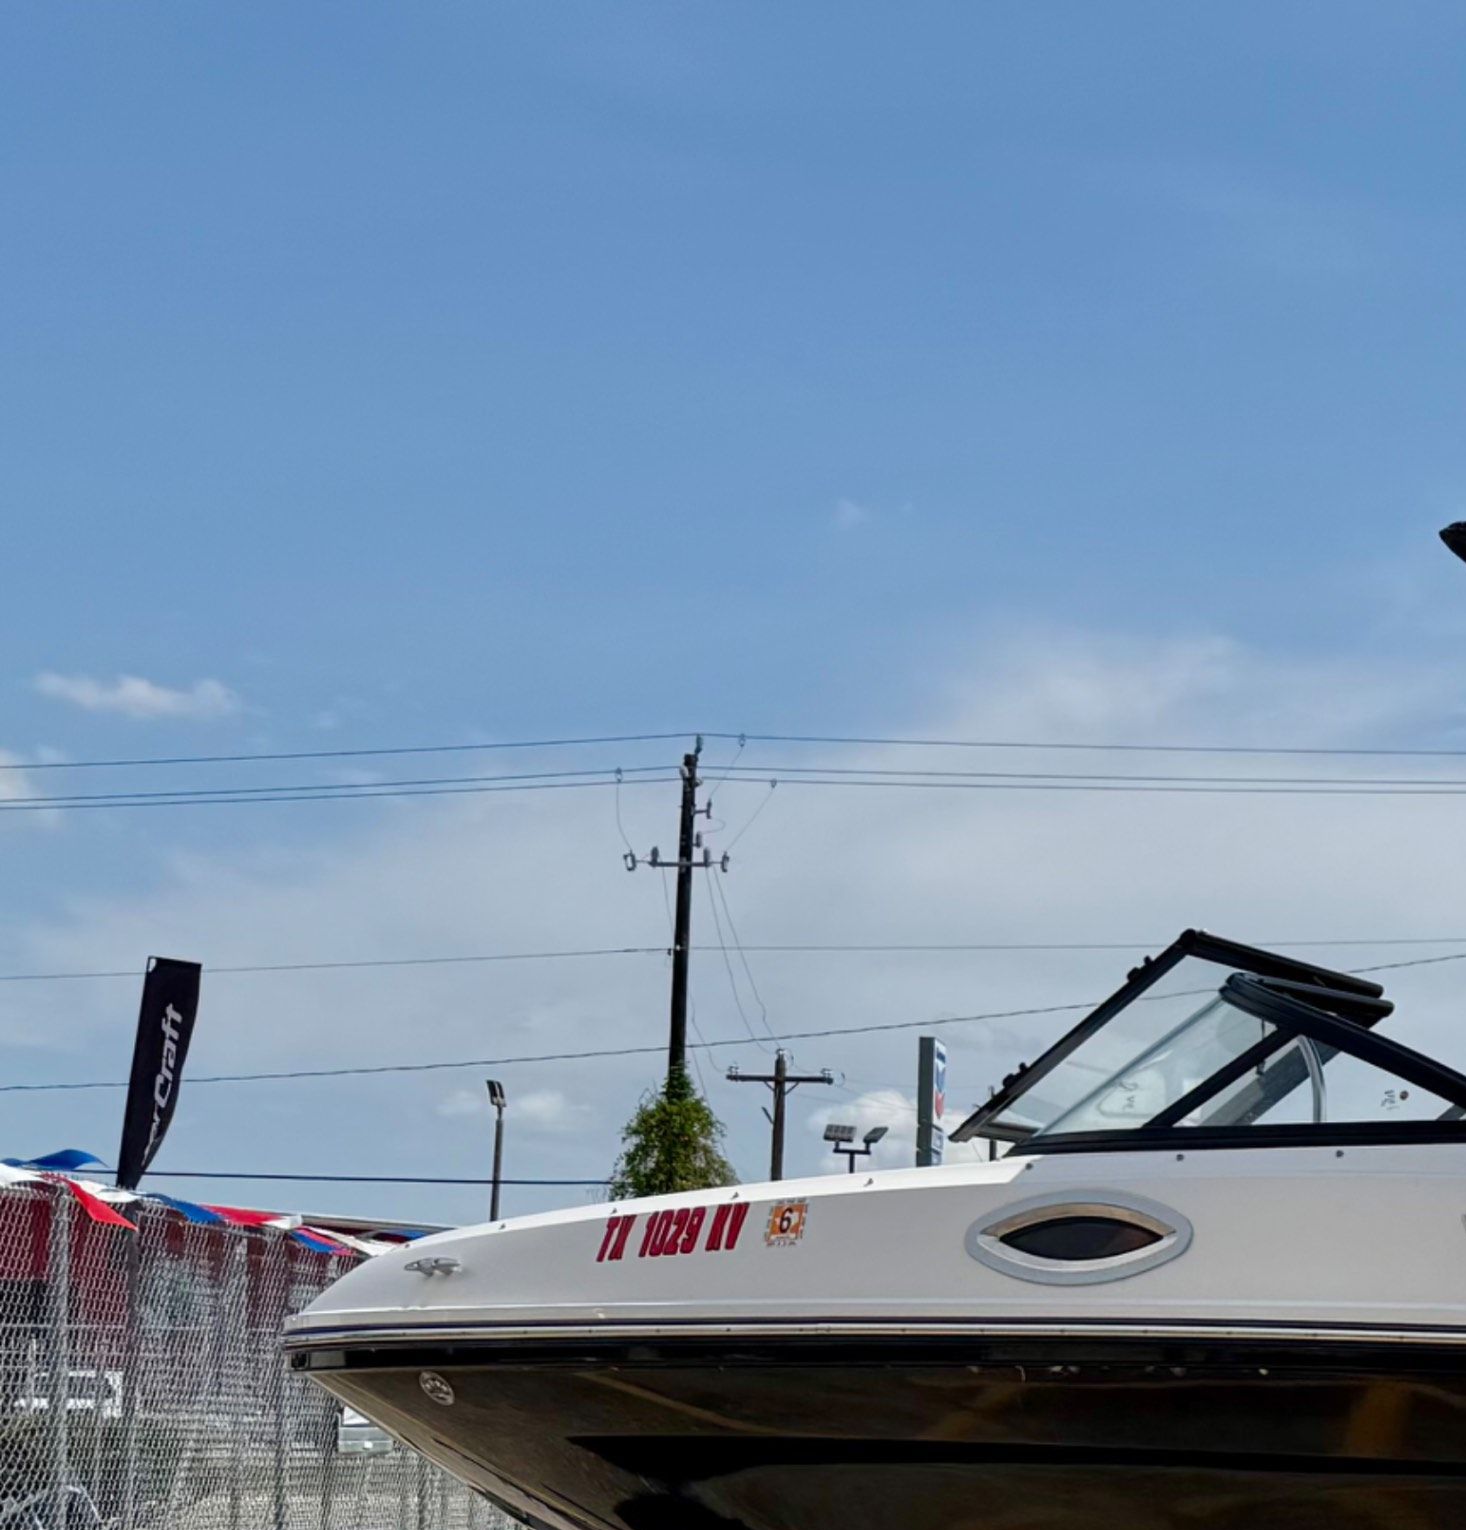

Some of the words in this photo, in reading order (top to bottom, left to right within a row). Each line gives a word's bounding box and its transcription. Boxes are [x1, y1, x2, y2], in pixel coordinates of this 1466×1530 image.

[596, 1214, 637, 1262] TX
[638, 1206, 706, 1257] 1029
[779, 1207, 794, 1234] 6
